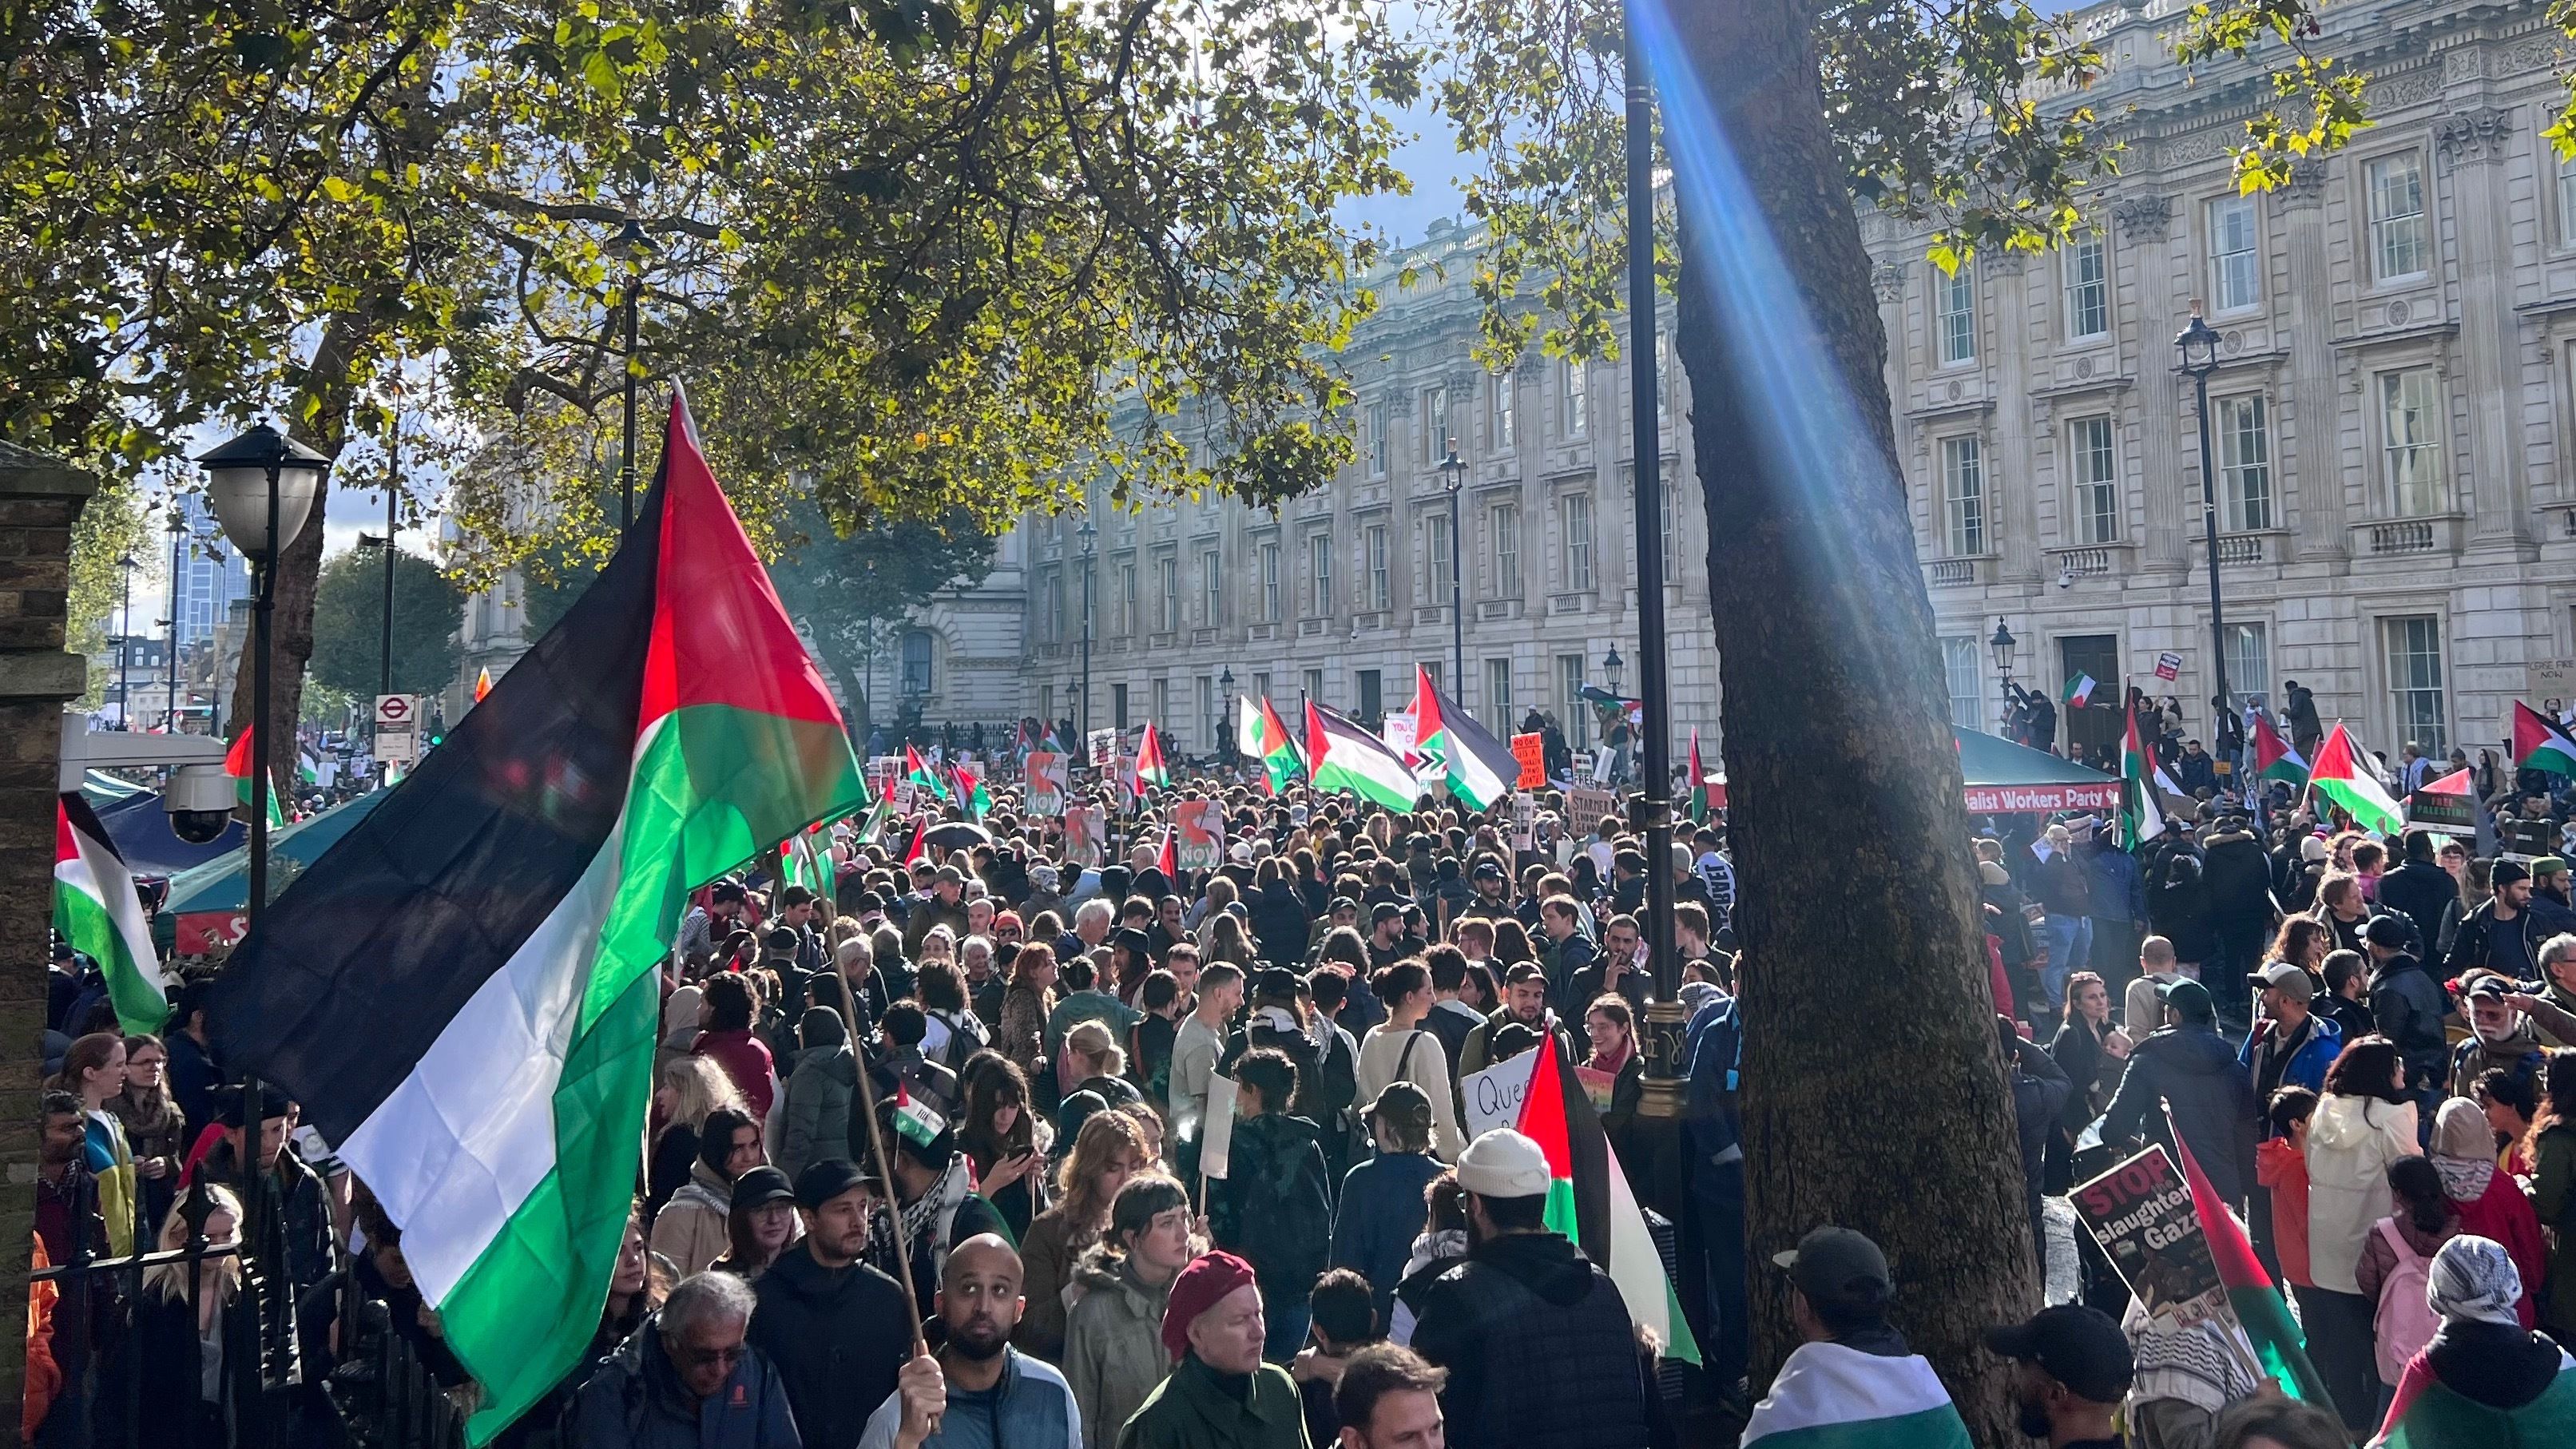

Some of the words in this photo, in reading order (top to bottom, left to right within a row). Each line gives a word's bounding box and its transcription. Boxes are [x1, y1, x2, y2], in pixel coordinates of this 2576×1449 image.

[2540, 670, 2563, 679] NOW
[1392, 723, 1407, 732] YOU
[1574, 773, 1594, 786] FREE
[1572, 796, 1610, 814] STARMER
[1964, 792, 1998, 811] ialist
[2000, 789, 2062, 809] Workers
[2066, 788, 2102, 808] Party
[2417, 805, 2467, 818] PALESTINE
[1576, 823, 1598, 833] GENO
[1478, 1075, 1530, 1116] Que
[2082, 1151, 2171, 1217] STOP
[2095, 1185, 2192, 1246] slaughter
